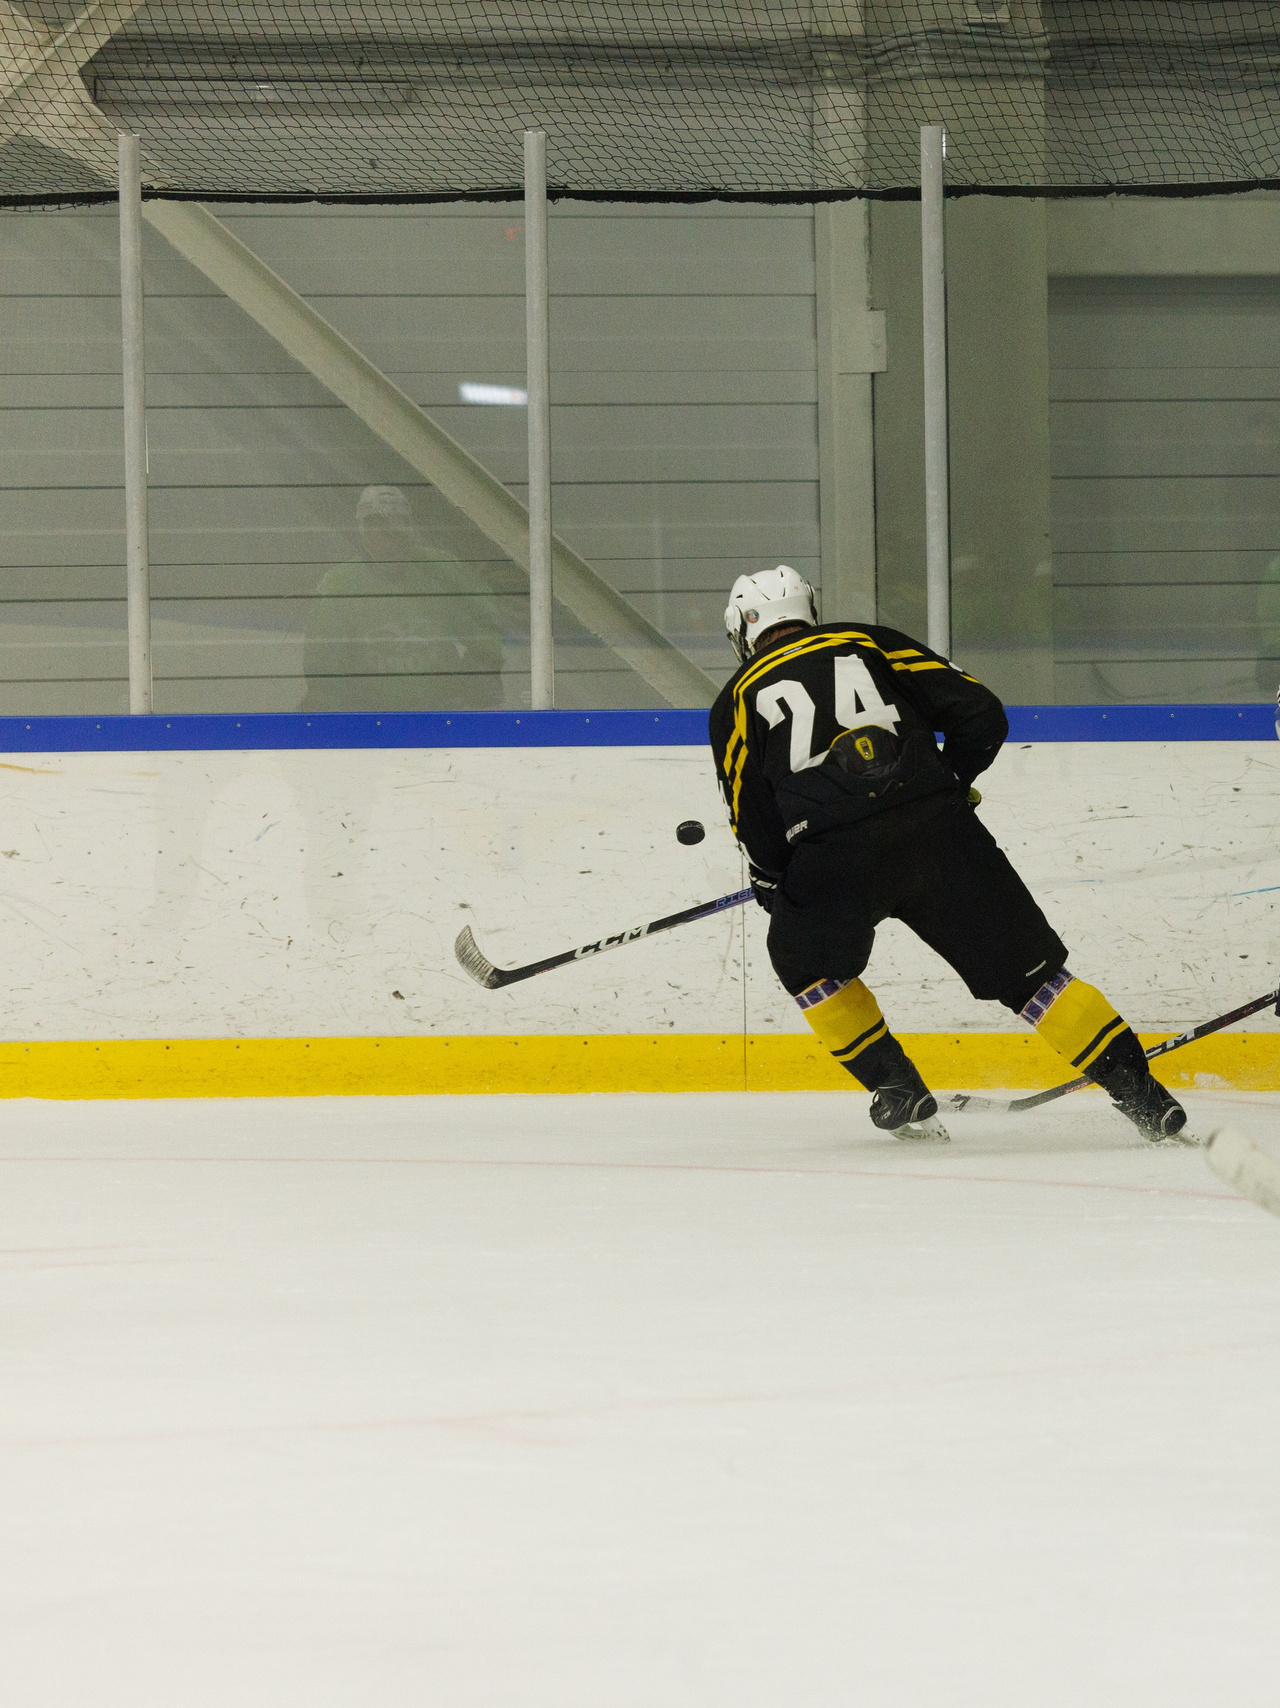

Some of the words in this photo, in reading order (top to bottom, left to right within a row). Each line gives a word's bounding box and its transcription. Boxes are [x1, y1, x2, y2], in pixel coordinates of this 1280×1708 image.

[756, 653, 902, 774] 24
[574, 922, 651, 960] CCM
[1143, 1029, 1195, 1059] CM
